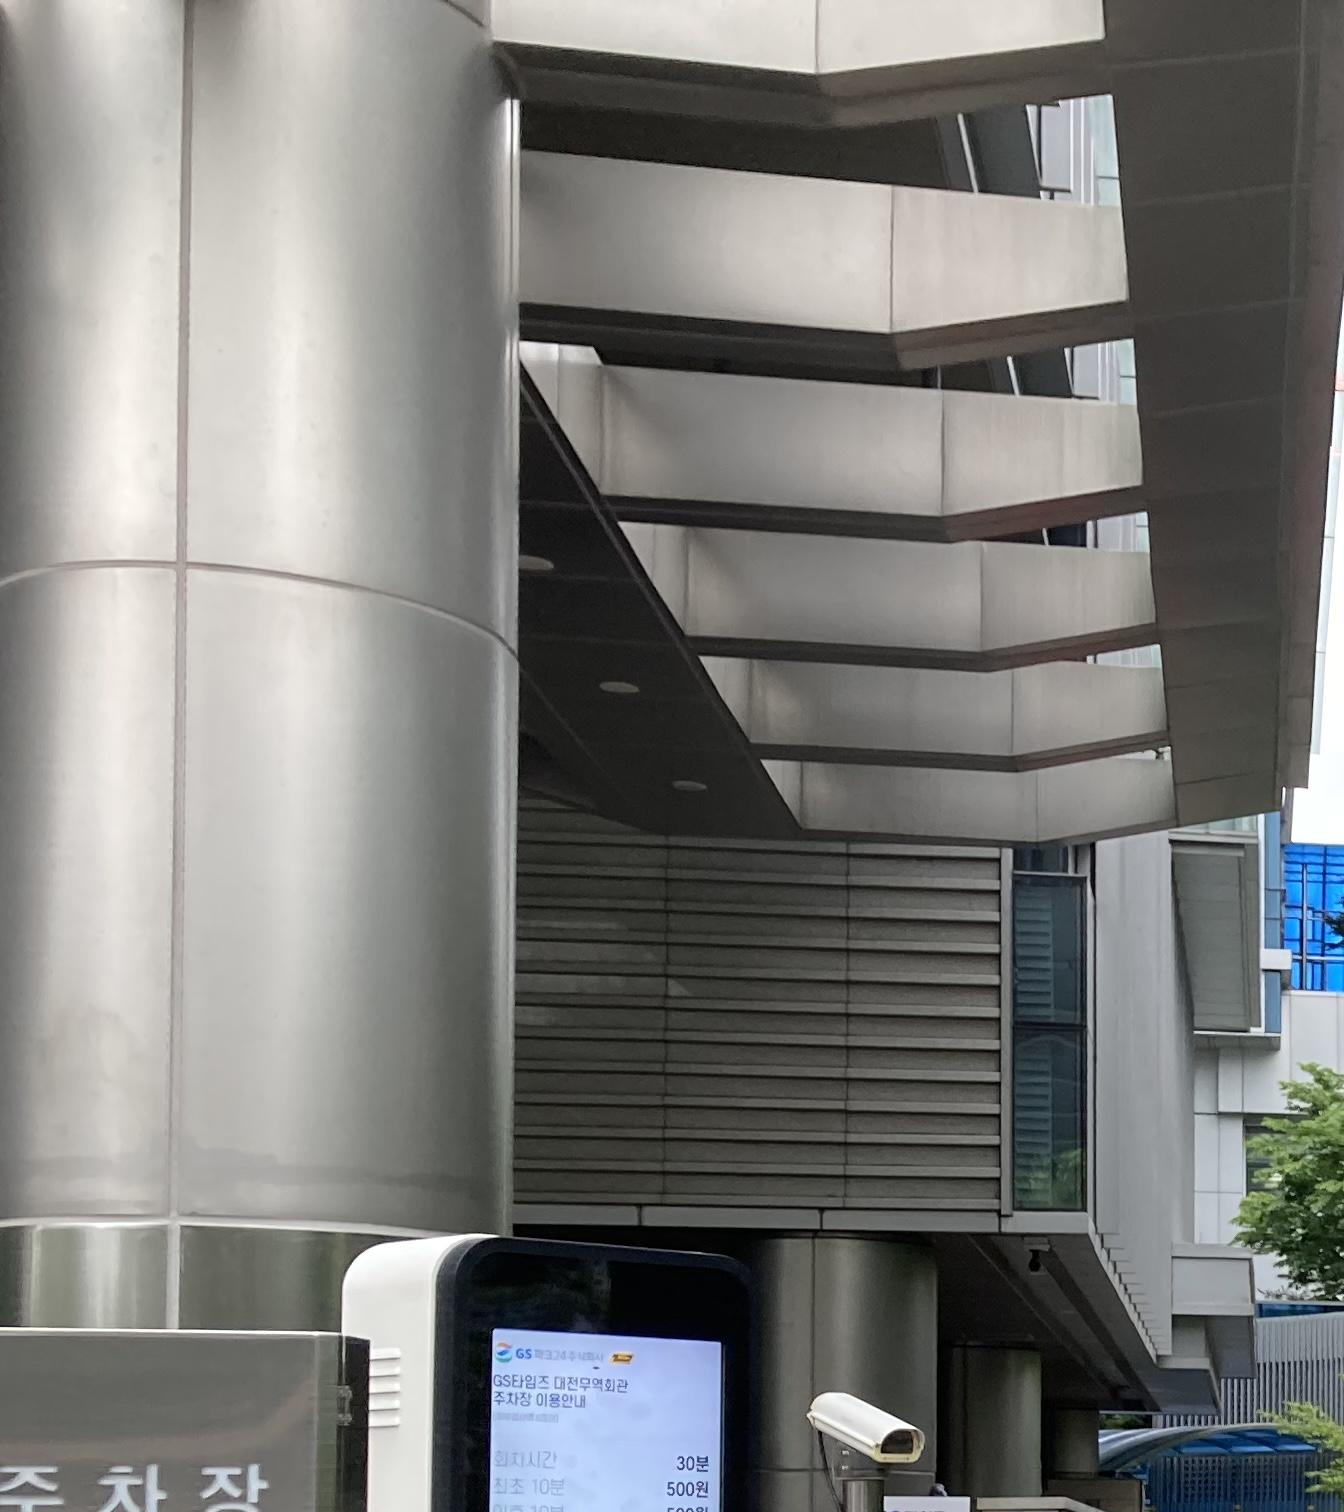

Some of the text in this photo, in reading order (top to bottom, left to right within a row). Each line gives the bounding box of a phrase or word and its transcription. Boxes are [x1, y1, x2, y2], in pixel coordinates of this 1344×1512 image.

[515, 1348, 532, 1360] GS
[493, 1374, 629, 1394] GS타임즈 대전무역회관
[493, 1391, 586, 1409] 주차장 이용안내
[676, 1455, 709, 1473] 30분
[531, 1478, 565, 1496] 10분
[666, 1481, 709, 1499] 500원
